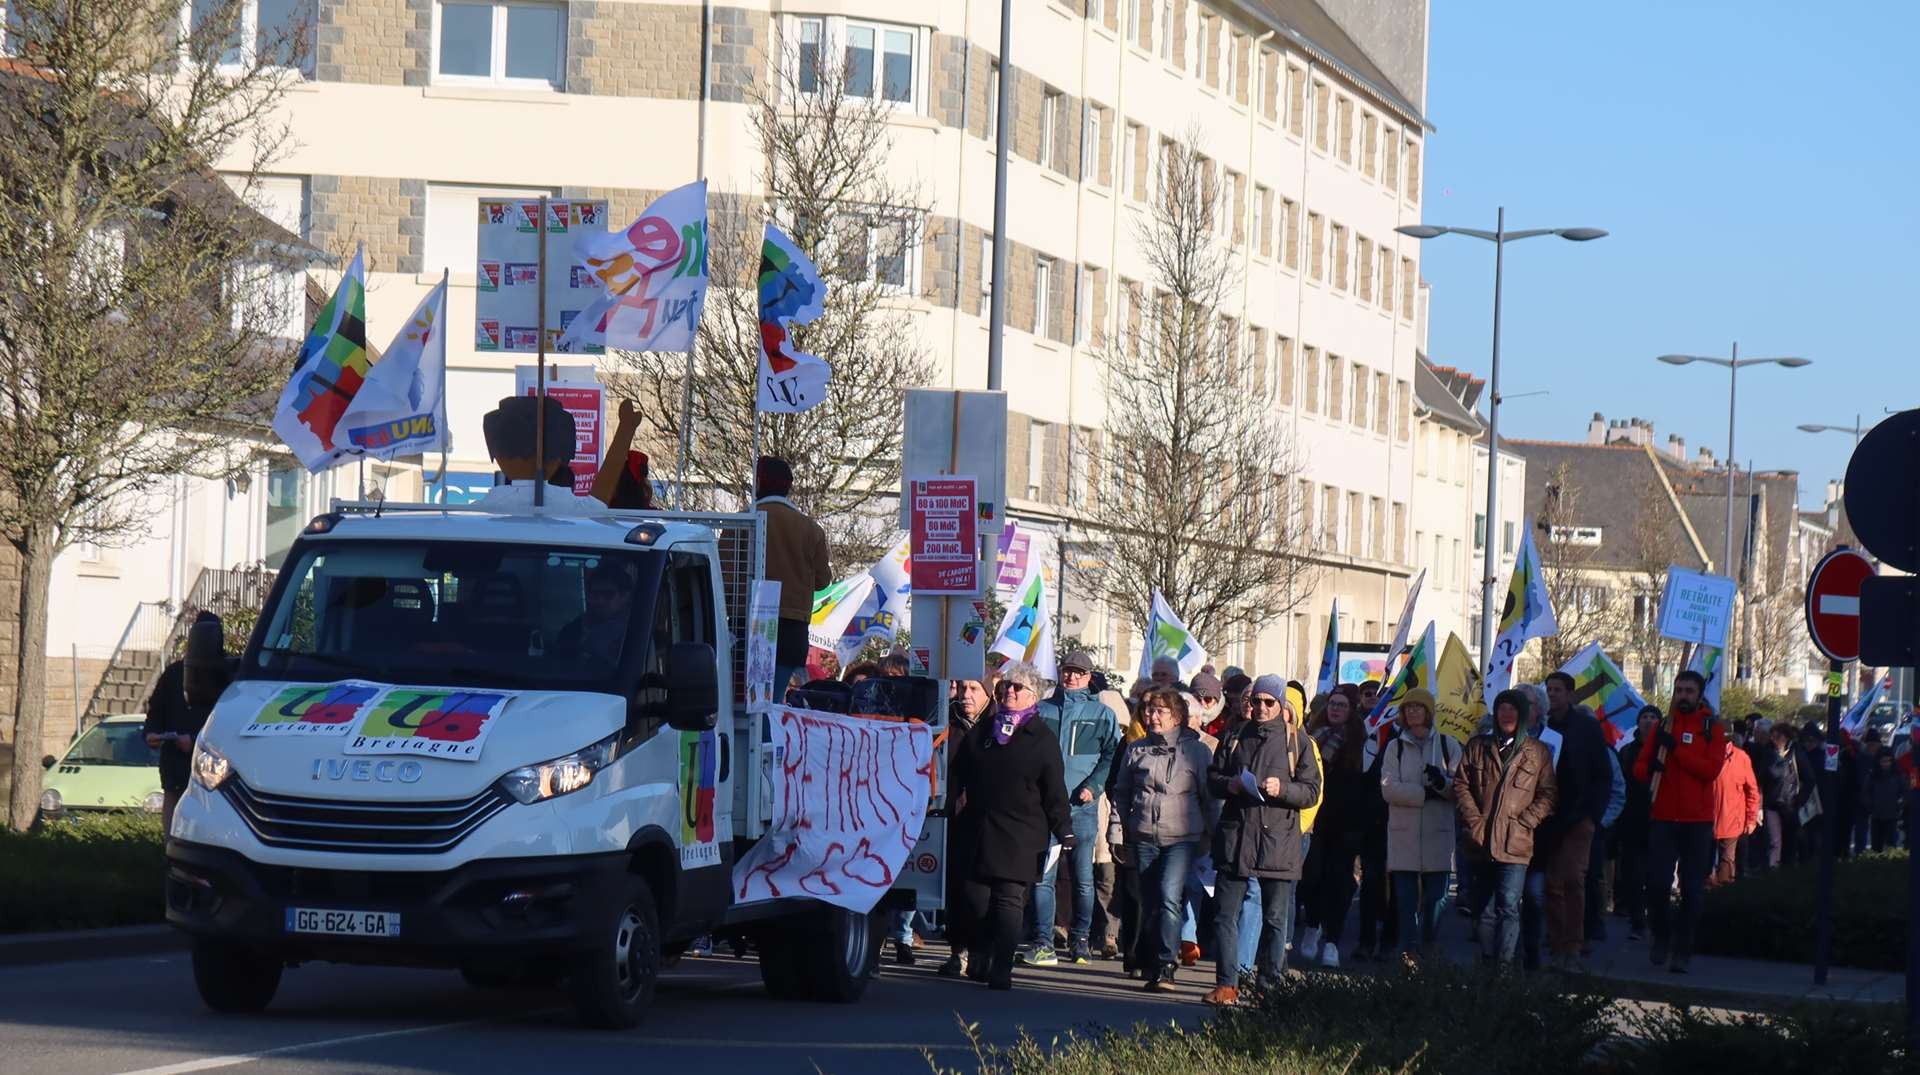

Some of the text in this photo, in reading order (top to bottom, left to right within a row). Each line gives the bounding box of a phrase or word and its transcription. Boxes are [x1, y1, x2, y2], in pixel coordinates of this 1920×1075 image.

[926, 543, 941, 554] 200
[1680, 588, 1724, 607] RETRAITE
[247, 723, 351, 733] Bretagne
[352, 736, 476, 754] Bretagne
[312, 758, 423, 784] IVECO
